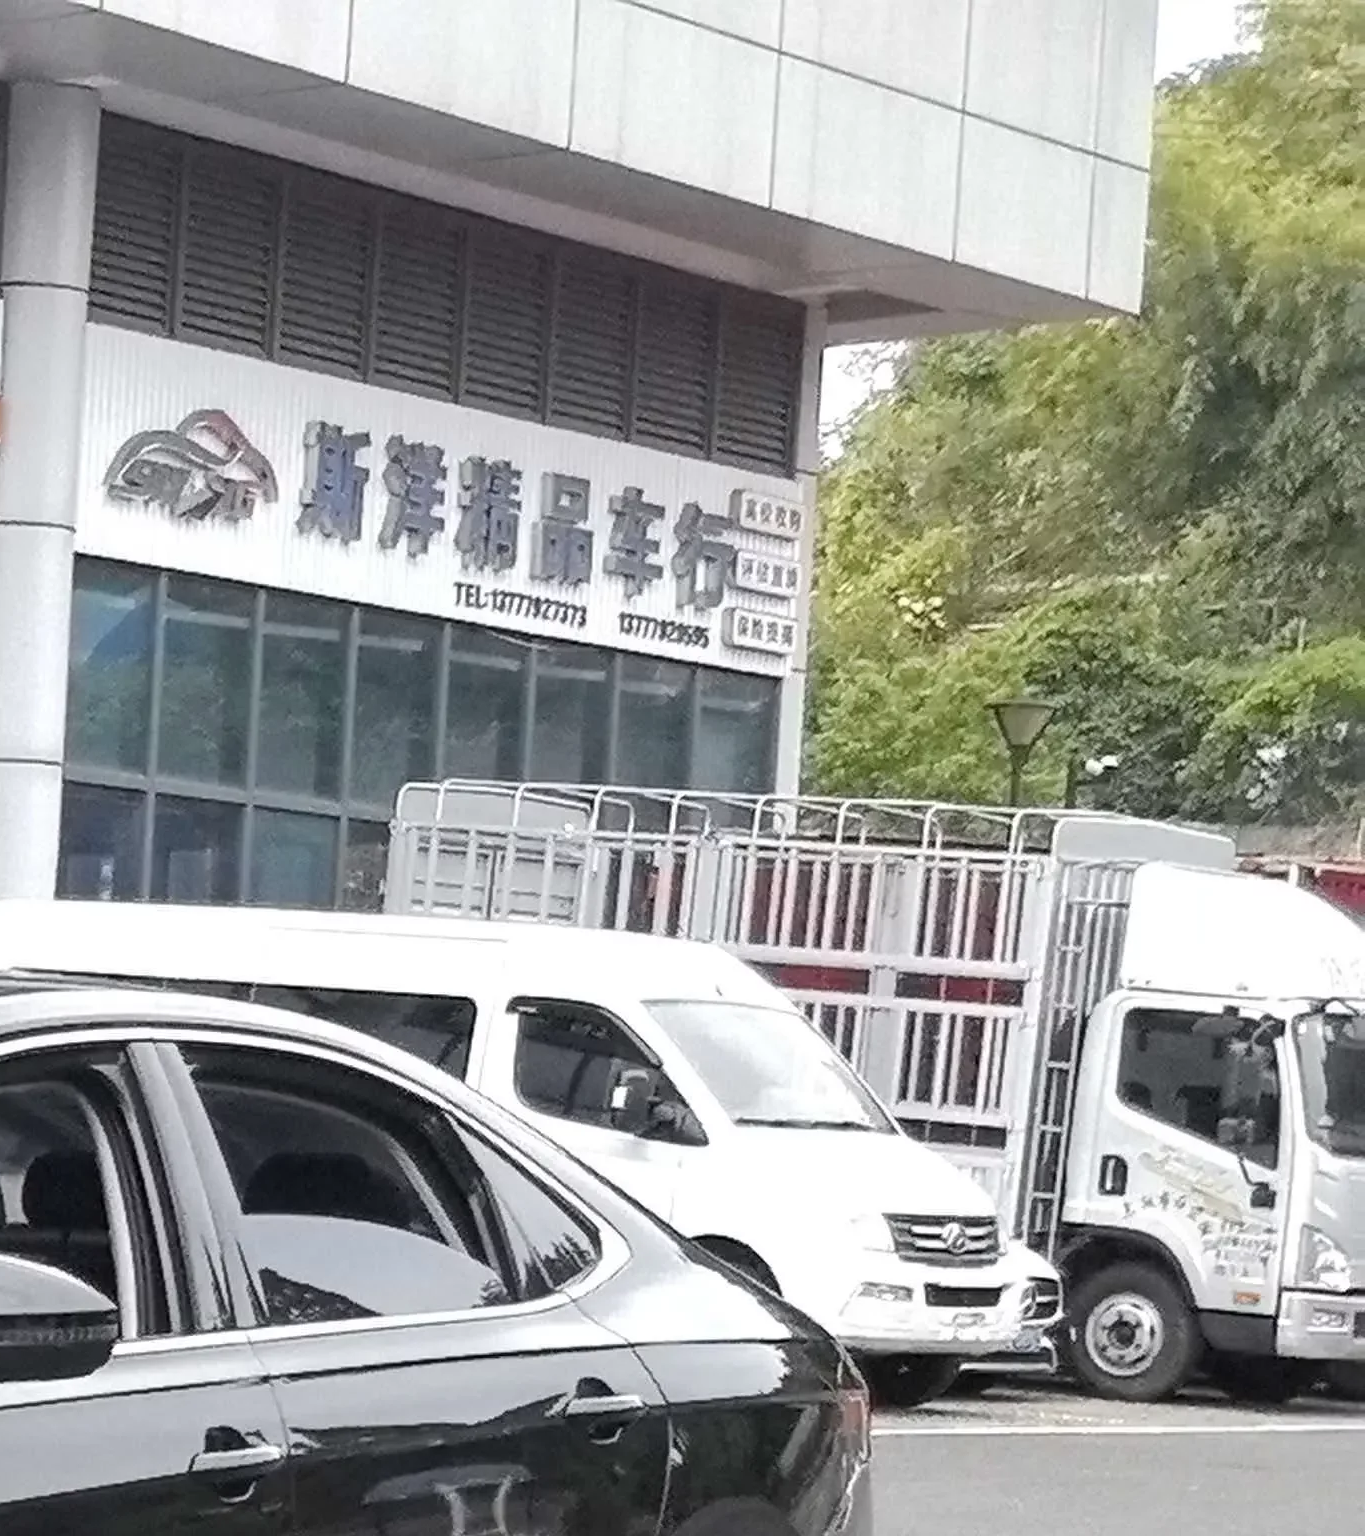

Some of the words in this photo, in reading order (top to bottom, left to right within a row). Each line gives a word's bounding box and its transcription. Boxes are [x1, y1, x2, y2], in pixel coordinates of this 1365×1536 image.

[296, 419, 738, 611] 斯洋精品车行
